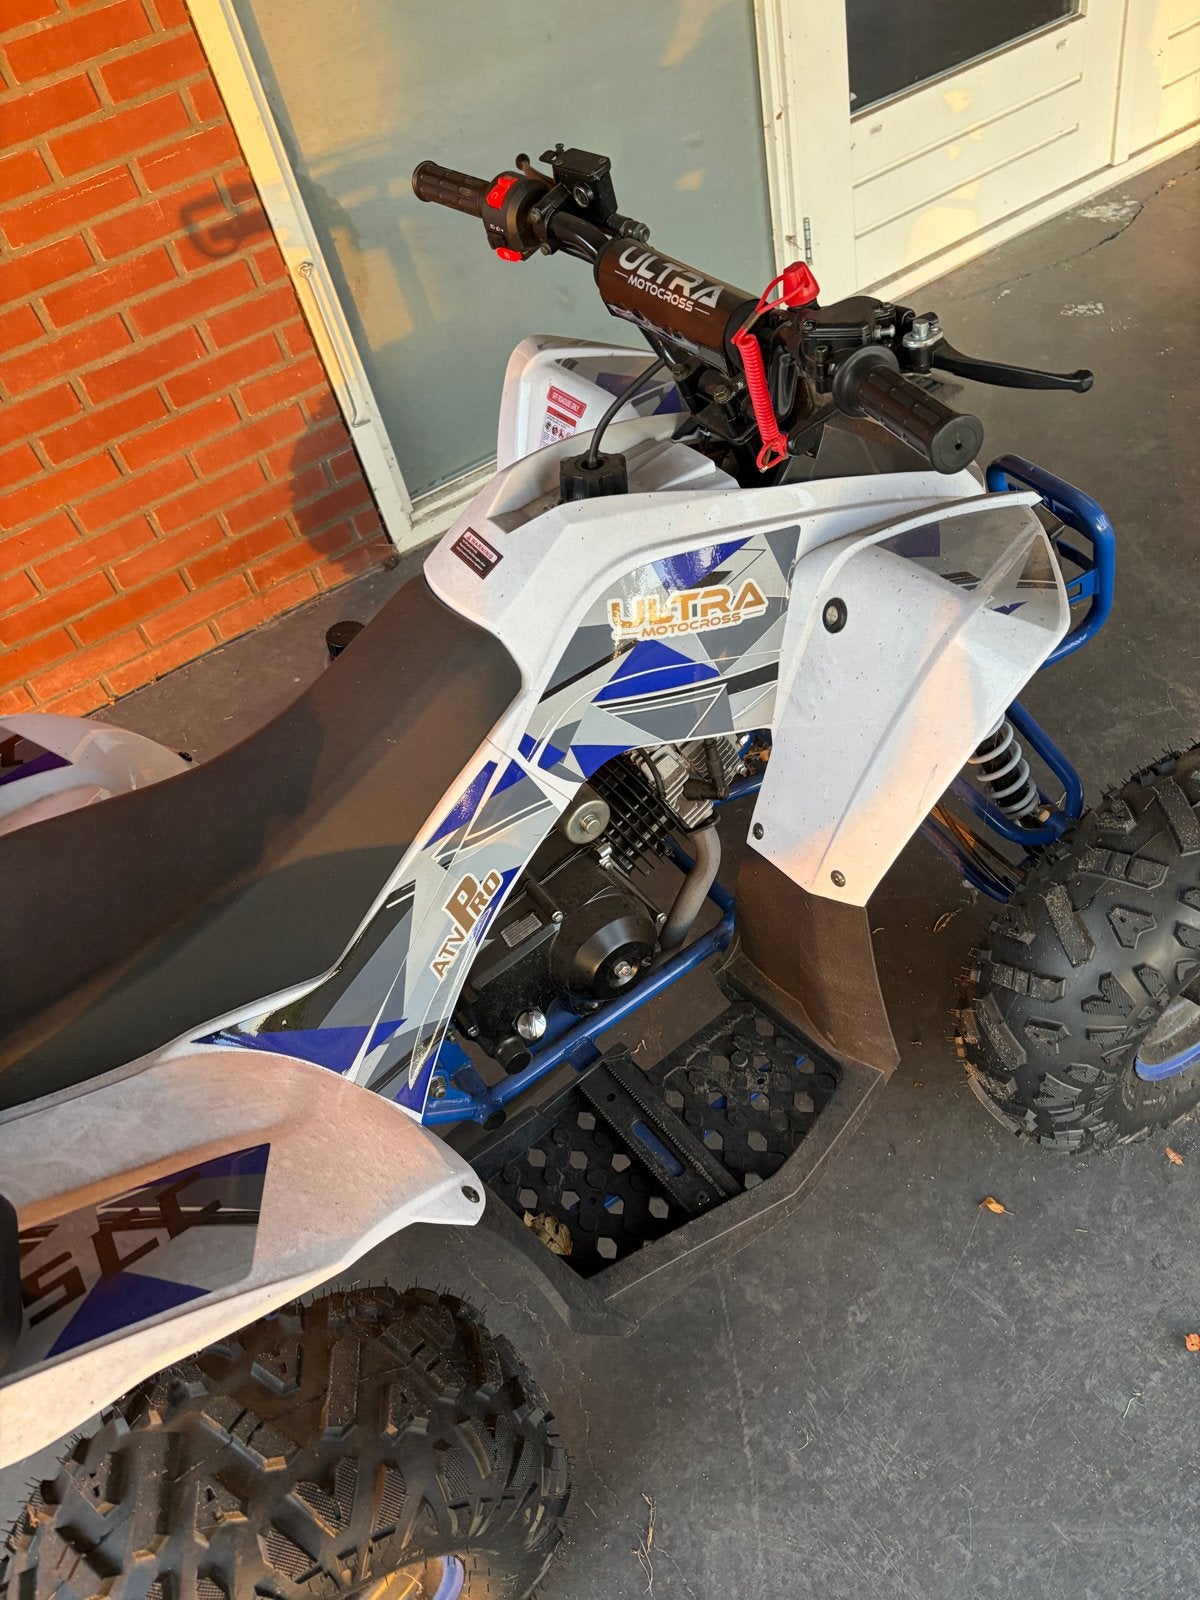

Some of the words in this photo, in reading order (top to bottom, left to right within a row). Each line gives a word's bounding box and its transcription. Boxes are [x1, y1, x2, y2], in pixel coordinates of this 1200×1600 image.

[619, 246, 724, 309] ULTRA
[627, 274, 695, 312] MOTOCROSS
[470, 537, 494, 560] WARNING
[611, 581, 765, 628] ULTRA
[641, 612, 741, 637] MOTOCROSS
[432, 925, 465, 978] ATV
